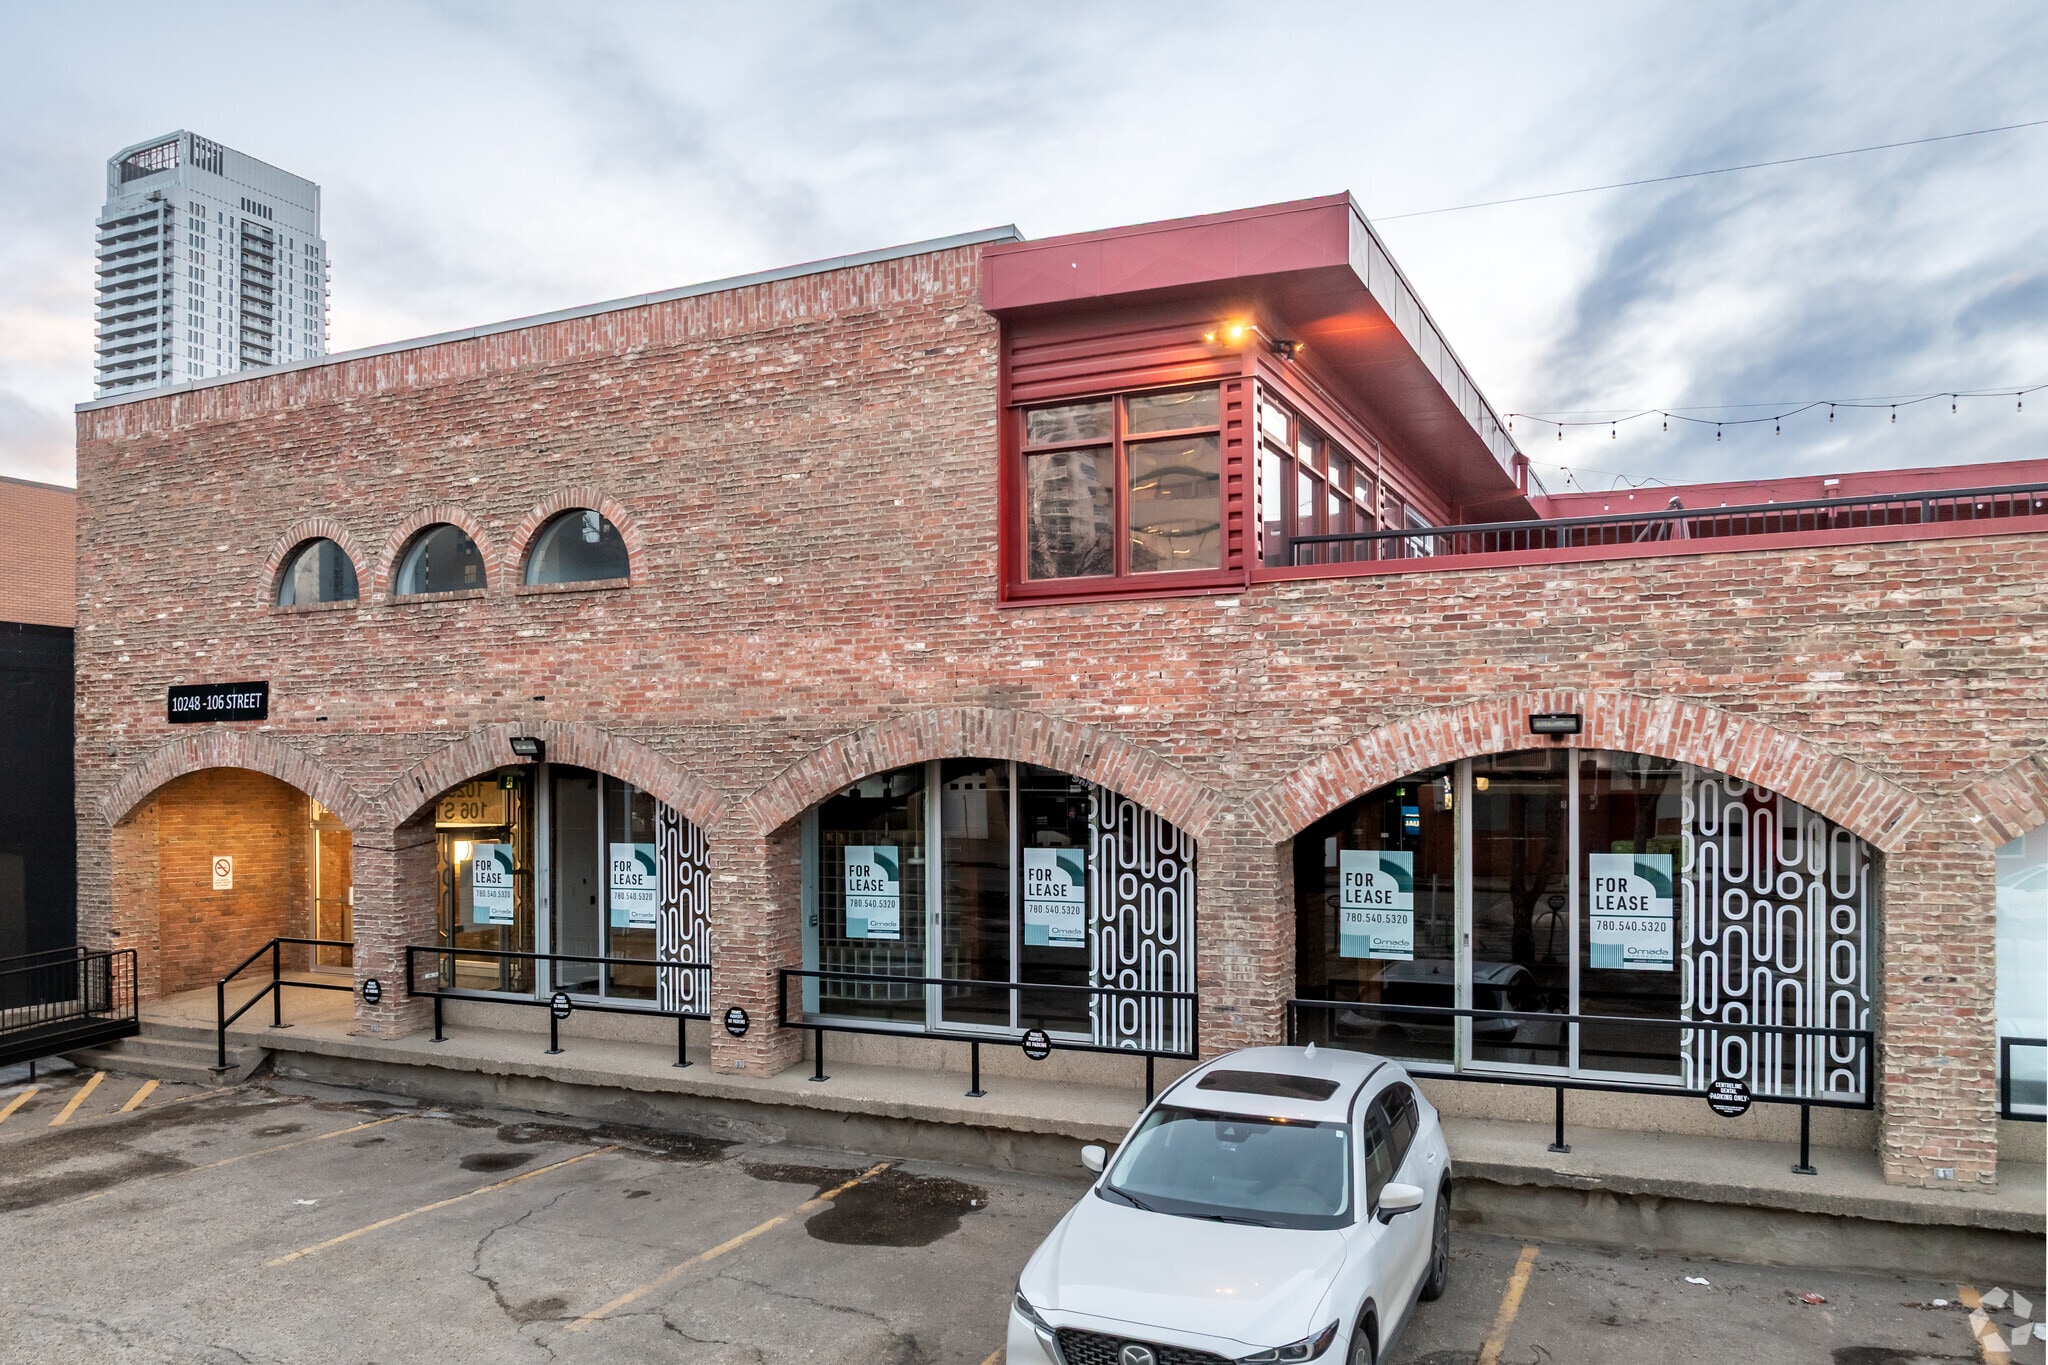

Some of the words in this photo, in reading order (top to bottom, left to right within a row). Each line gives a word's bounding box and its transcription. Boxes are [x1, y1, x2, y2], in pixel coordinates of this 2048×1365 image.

[172, 696, 201, 712] 10248
[226, 693, 262, 709] STREET
[475, 860, 492, 871] FOR
[614, 861, 632, 872] FOR
[849, 865, 870, 877] FOR
[475, 873, 502, 884] LEASE
[614, 874, 643, 885] LEASE
[1029, 868, 1052, 881] FOR
[1346, 873, 1374, 887] FOR
[850, 879, 884, 891] LEASE
[1029, 884, 1067, 897] LEASE
[1596, 878, 1628, 893] FOR
[476, 890, 511, 898] 780.540.5320
[614, 892, 653, 900] 780.540.5320
[1346, 889, 1392, 904] LEASE
[850, 899, 896, 908] 780.540.5320
[1596, 896, 1649, 911] LEASE
[1029, 905, 1080, 915] 780.540.5320
[1346, 913, 1408, 924] 780.540.5320
[1597, 921, 1667, 932] 780.540.5320
[1373, 938, 1410, 946] Omada
[1627, 947, 1669, 955] Omada
